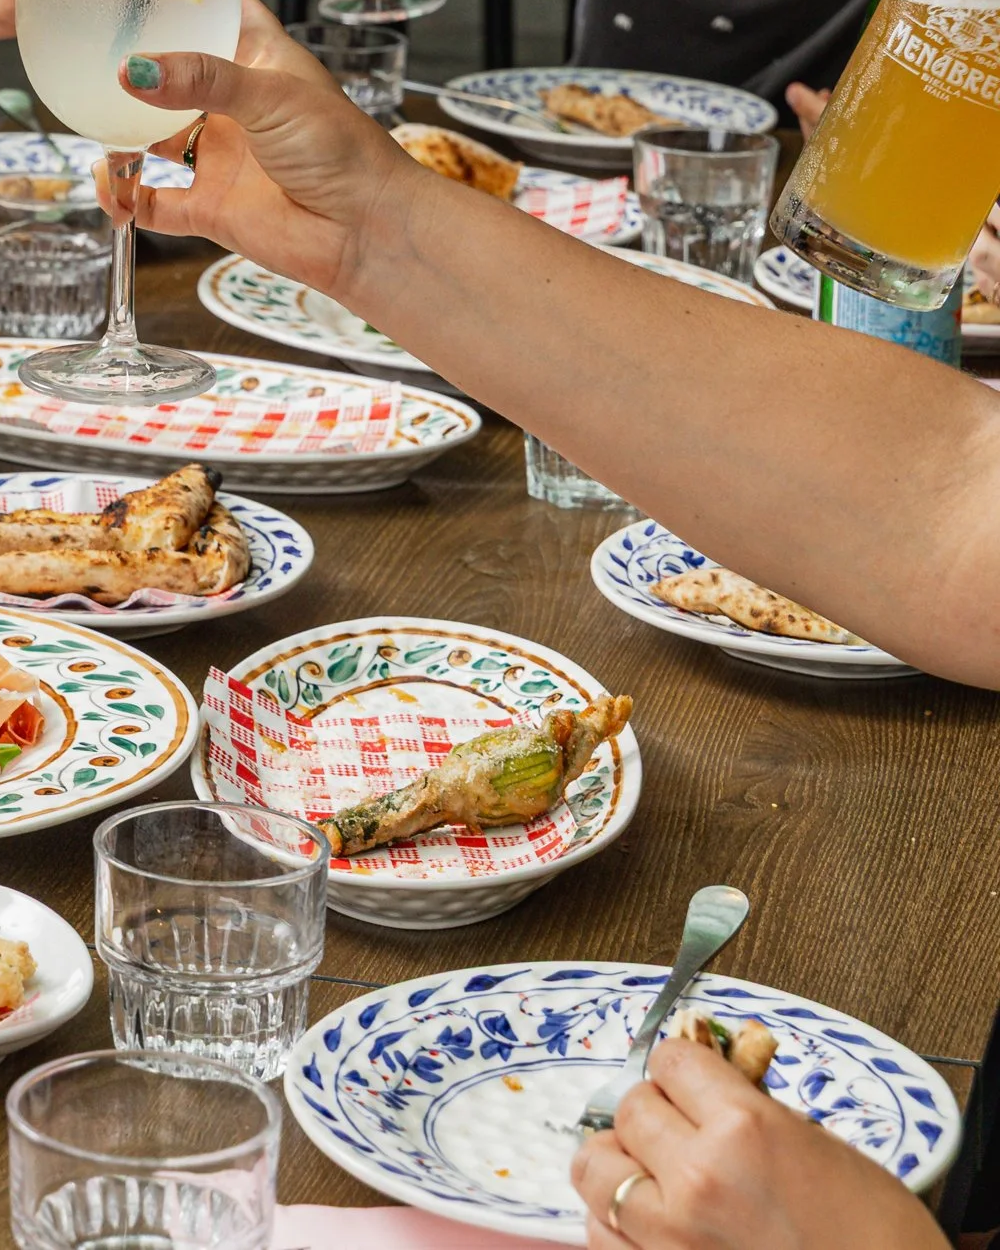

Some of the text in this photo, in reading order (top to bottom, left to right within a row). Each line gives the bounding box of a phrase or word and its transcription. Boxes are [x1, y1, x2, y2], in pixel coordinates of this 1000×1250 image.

[924, 29, 945, 45] DAL
[920, 72, 961, 98] BIELLA
[923, 84, 950, 102] ITALIA
